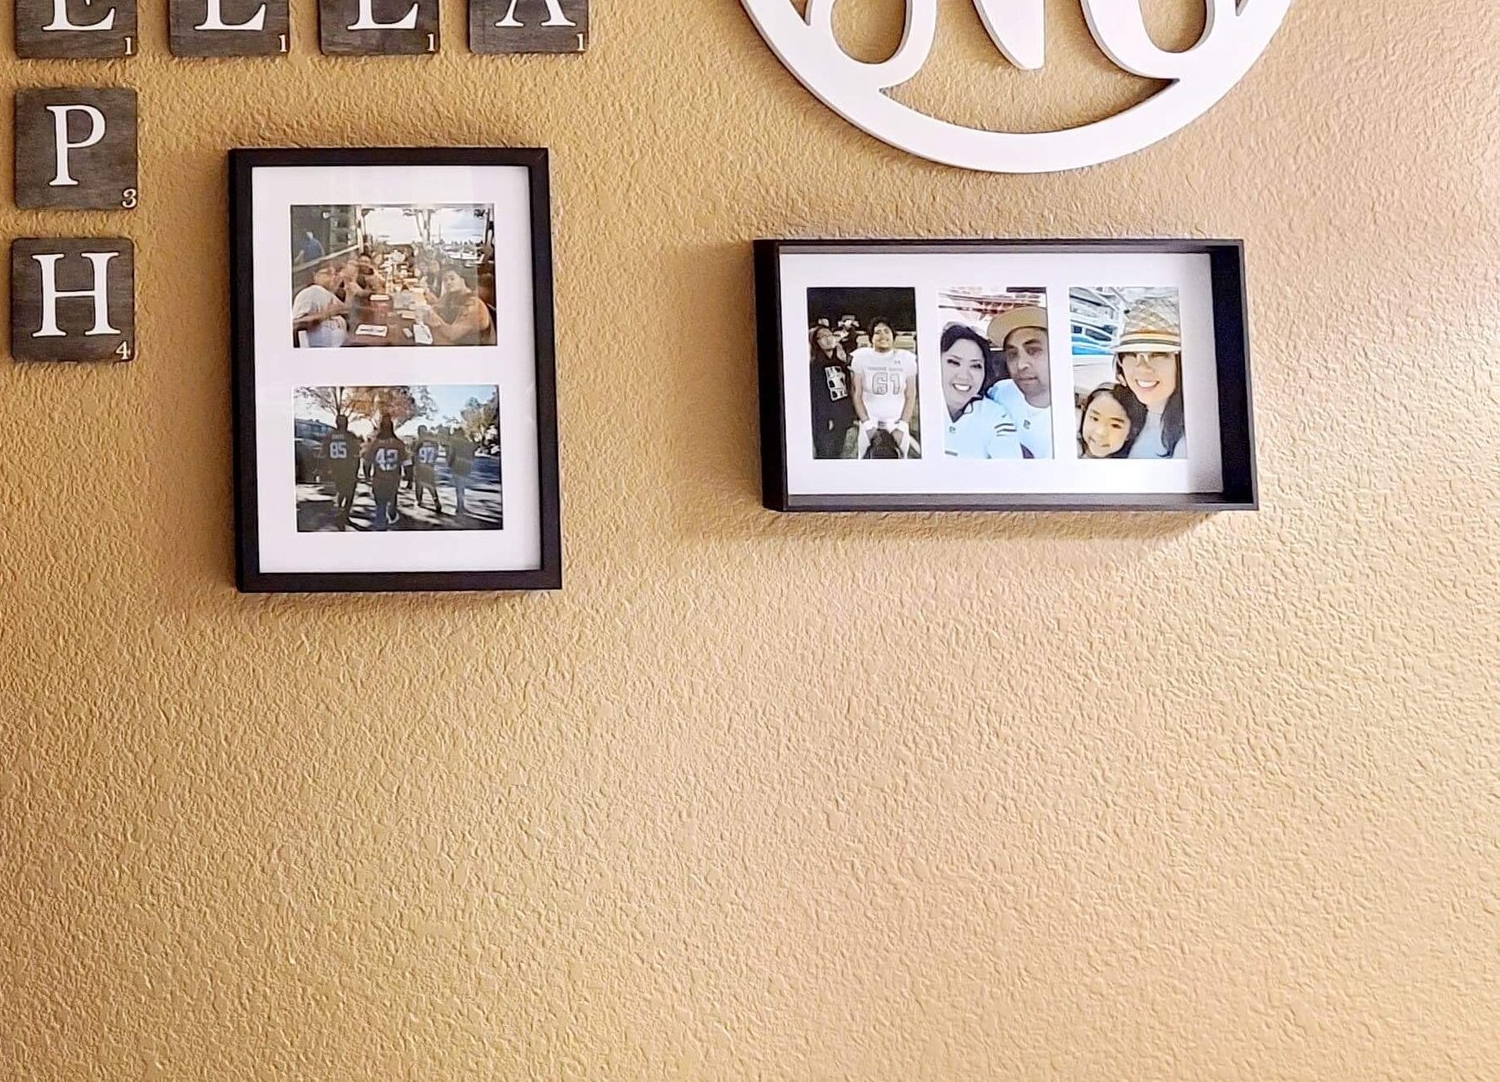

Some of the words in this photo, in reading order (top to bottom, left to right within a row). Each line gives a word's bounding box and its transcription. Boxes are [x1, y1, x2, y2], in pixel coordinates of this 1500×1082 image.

[121, 188, 138, 208] 3
[115, 341, 129, 360] 4
[871, 371, 900, 396] 61
[329, 441, 348, 459] 85
